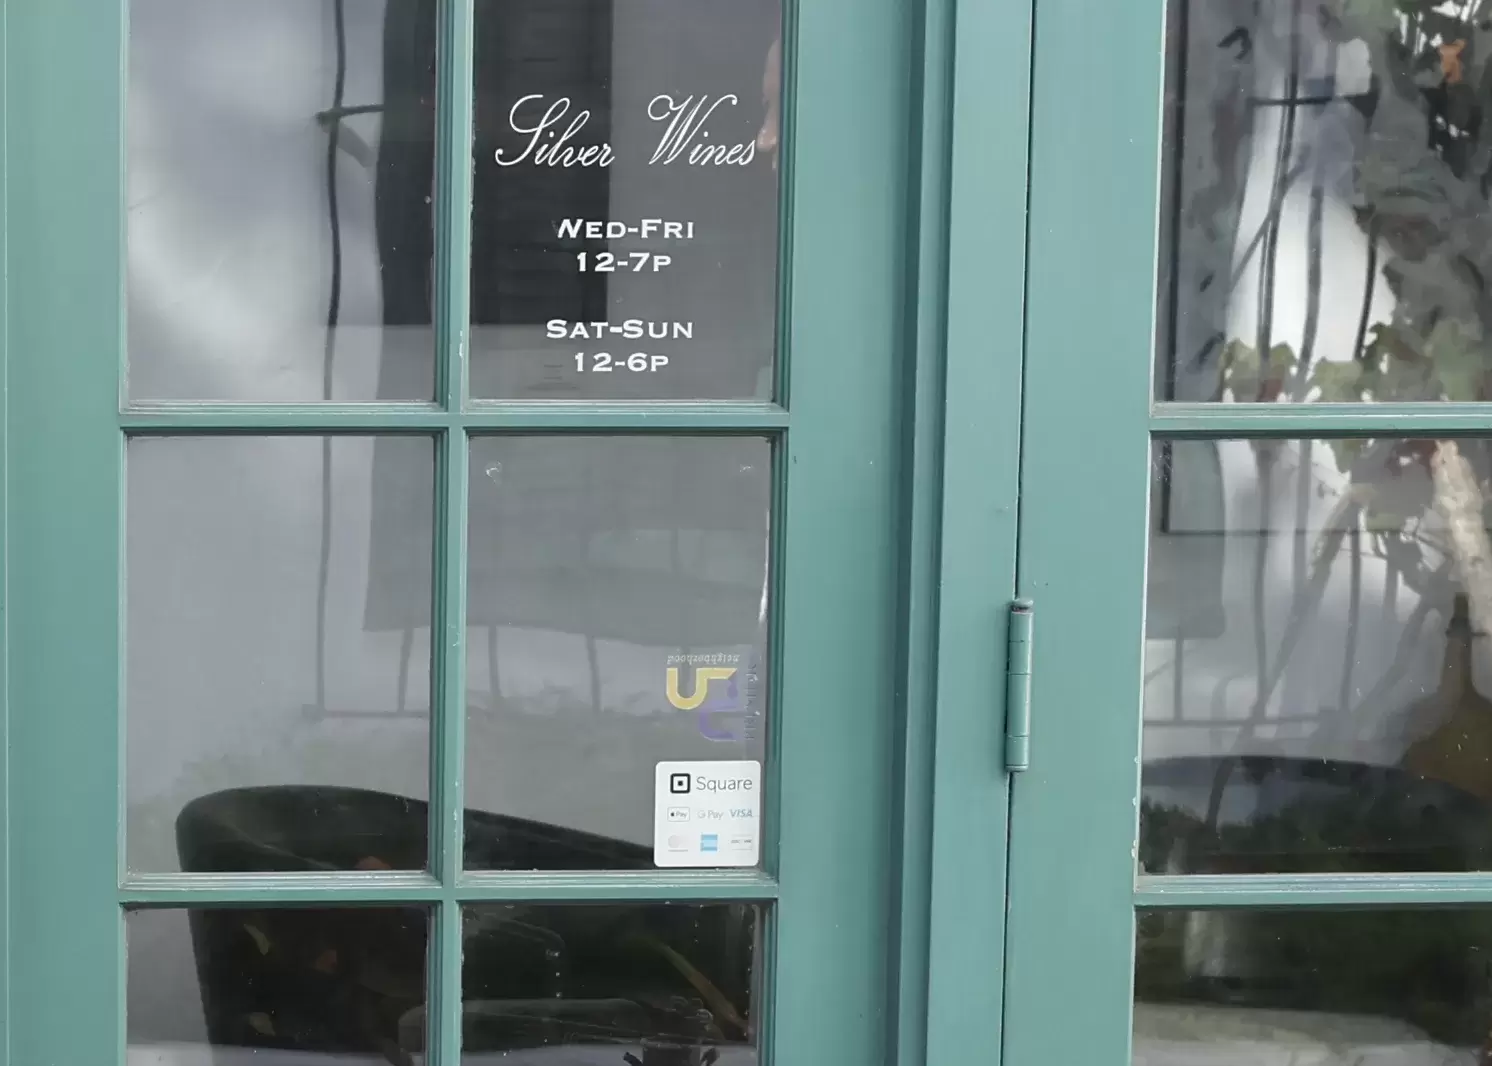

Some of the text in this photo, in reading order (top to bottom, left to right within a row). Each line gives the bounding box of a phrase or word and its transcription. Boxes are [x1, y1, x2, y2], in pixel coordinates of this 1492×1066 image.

[495, 94, 757, 167] Silver Wines
[577, 252, 672, 272] 12-7P
[574, 352, 669, 372] 12-6P
[667, 652, 741, 665] neighborhood
[696, 776, 753, 794] Square
[729, 809, 753, 818] VISA
